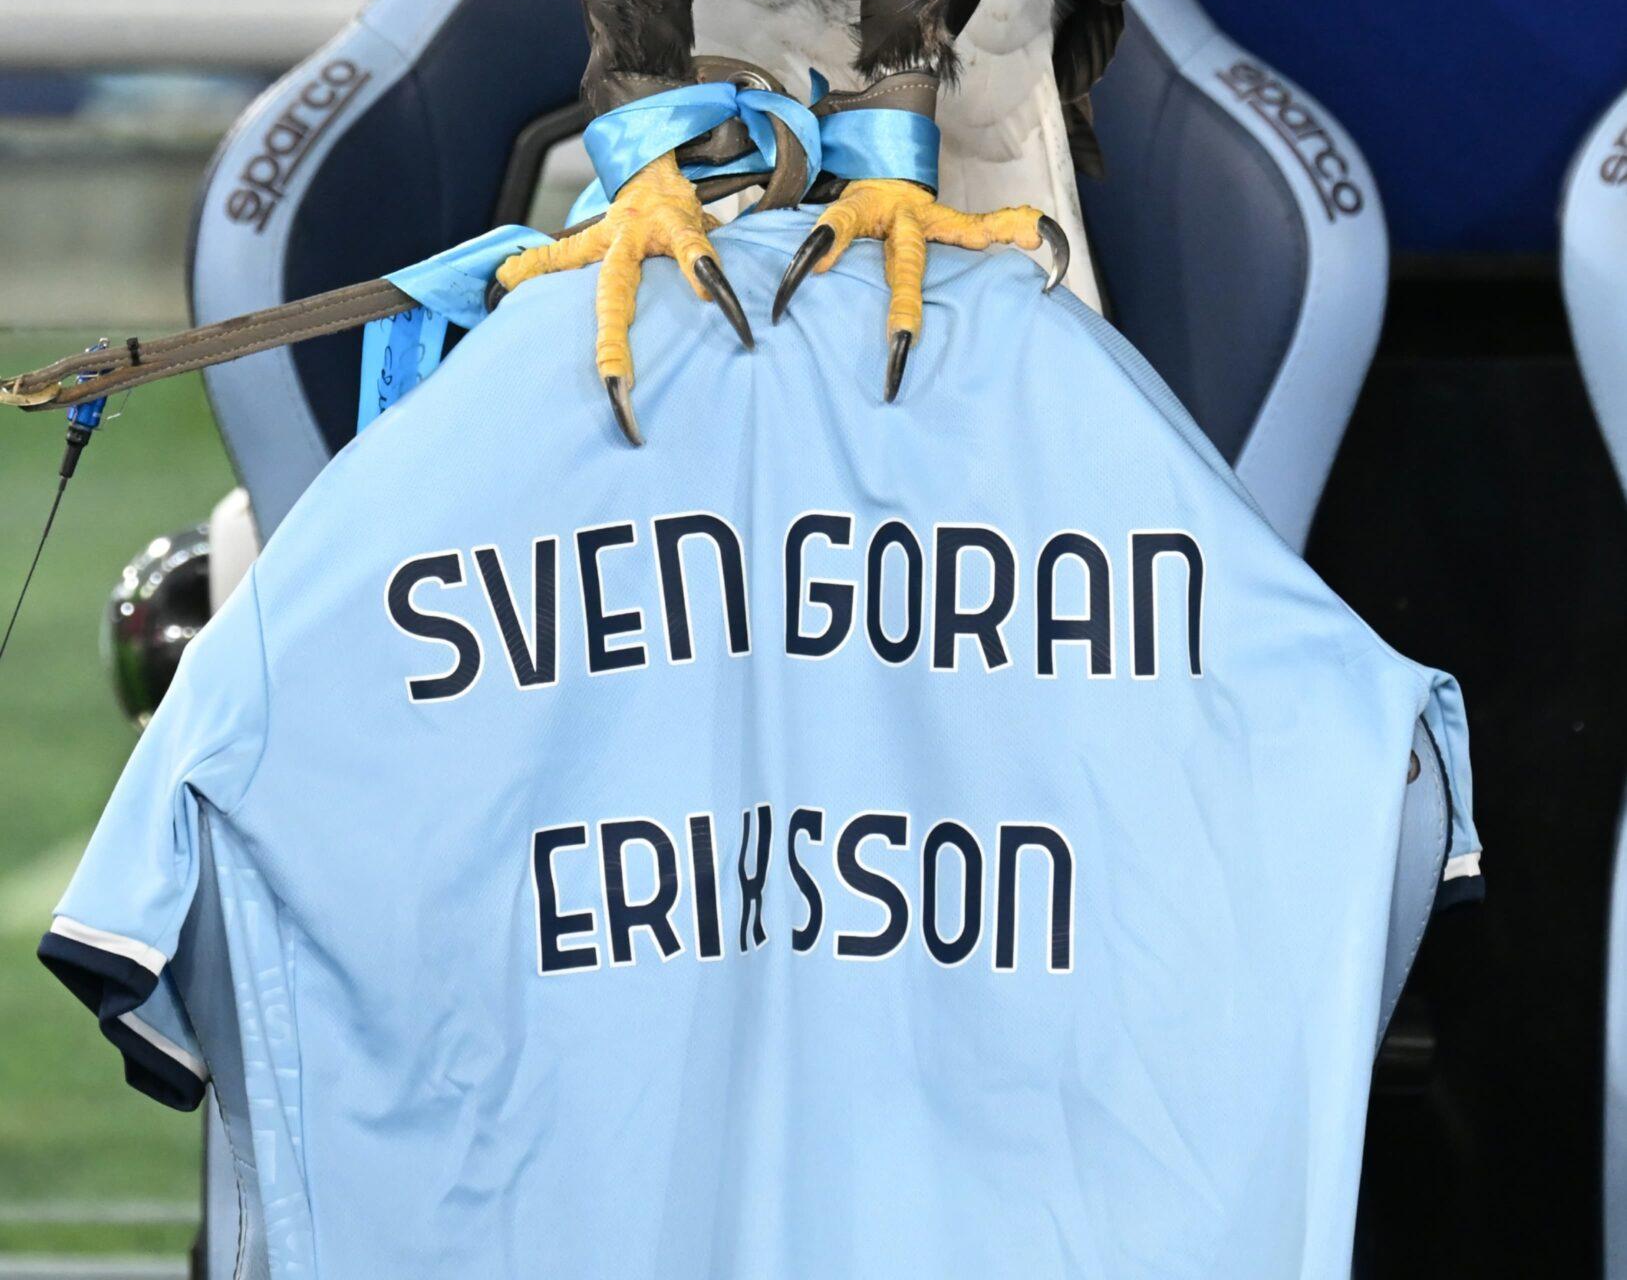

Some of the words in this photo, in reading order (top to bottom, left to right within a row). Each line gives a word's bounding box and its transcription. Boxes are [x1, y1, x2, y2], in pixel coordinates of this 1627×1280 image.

[225, 60, 372, 234] sparco
[1216, 63, 1364, 222] sparco
[383, 513, 750, 702] SVEN
[783, 513, 1206, 680] GORAN
[532, 801, 1075, 976] ERIKSSON
